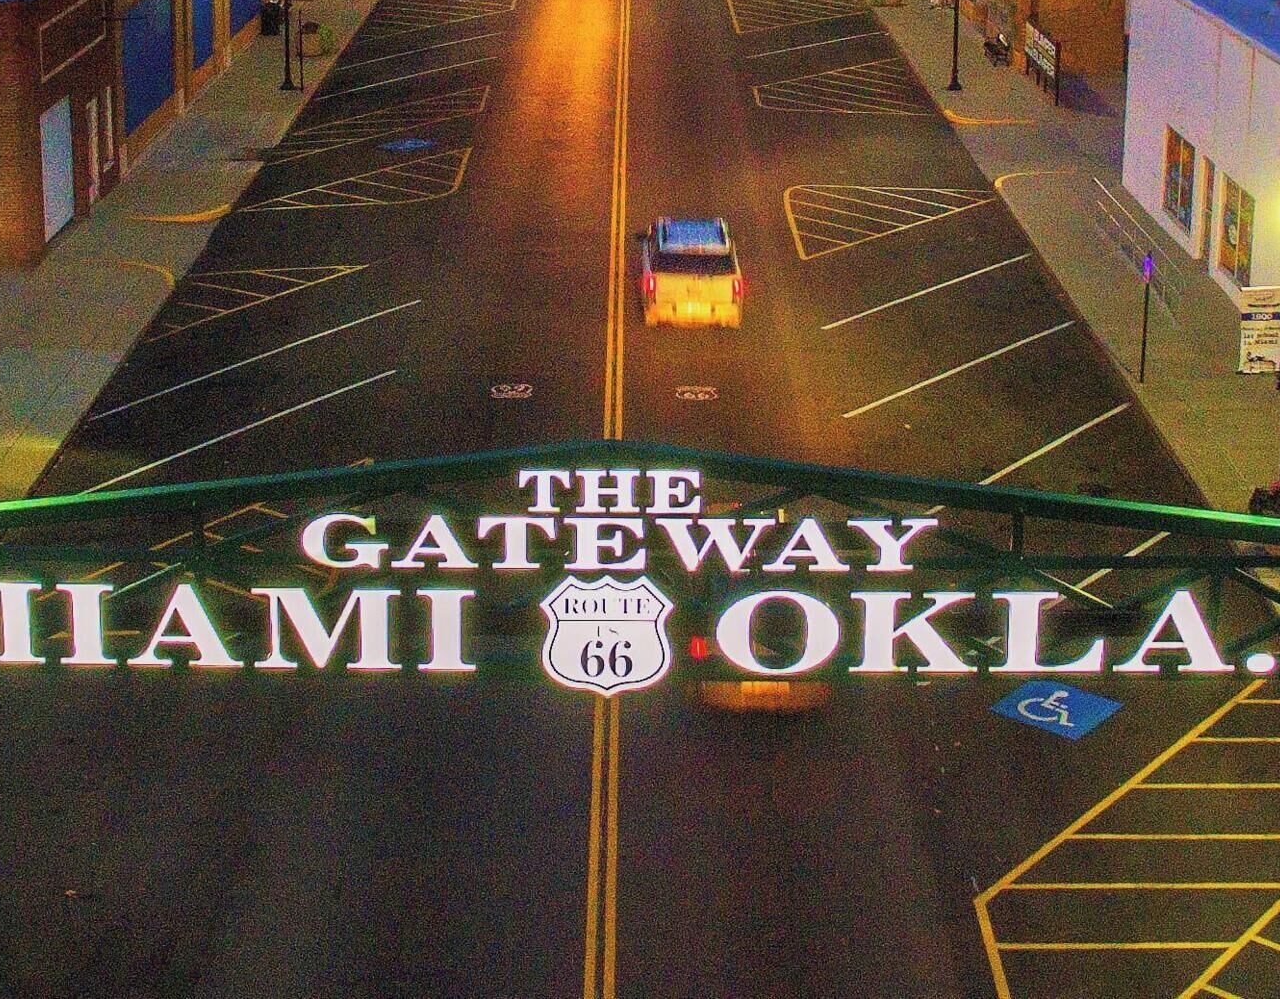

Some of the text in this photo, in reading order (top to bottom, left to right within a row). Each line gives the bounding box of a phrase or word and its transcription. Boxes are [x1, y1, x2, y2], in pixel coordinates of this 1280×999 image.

[518, 469, 701, 513] THE
[301, 513, 938, 572] GATEWAY
[564, 597, 651, 615] ROUTE
[715, 588, 1277, 676] OKLA.
[580, 640, 633, 678] 66
